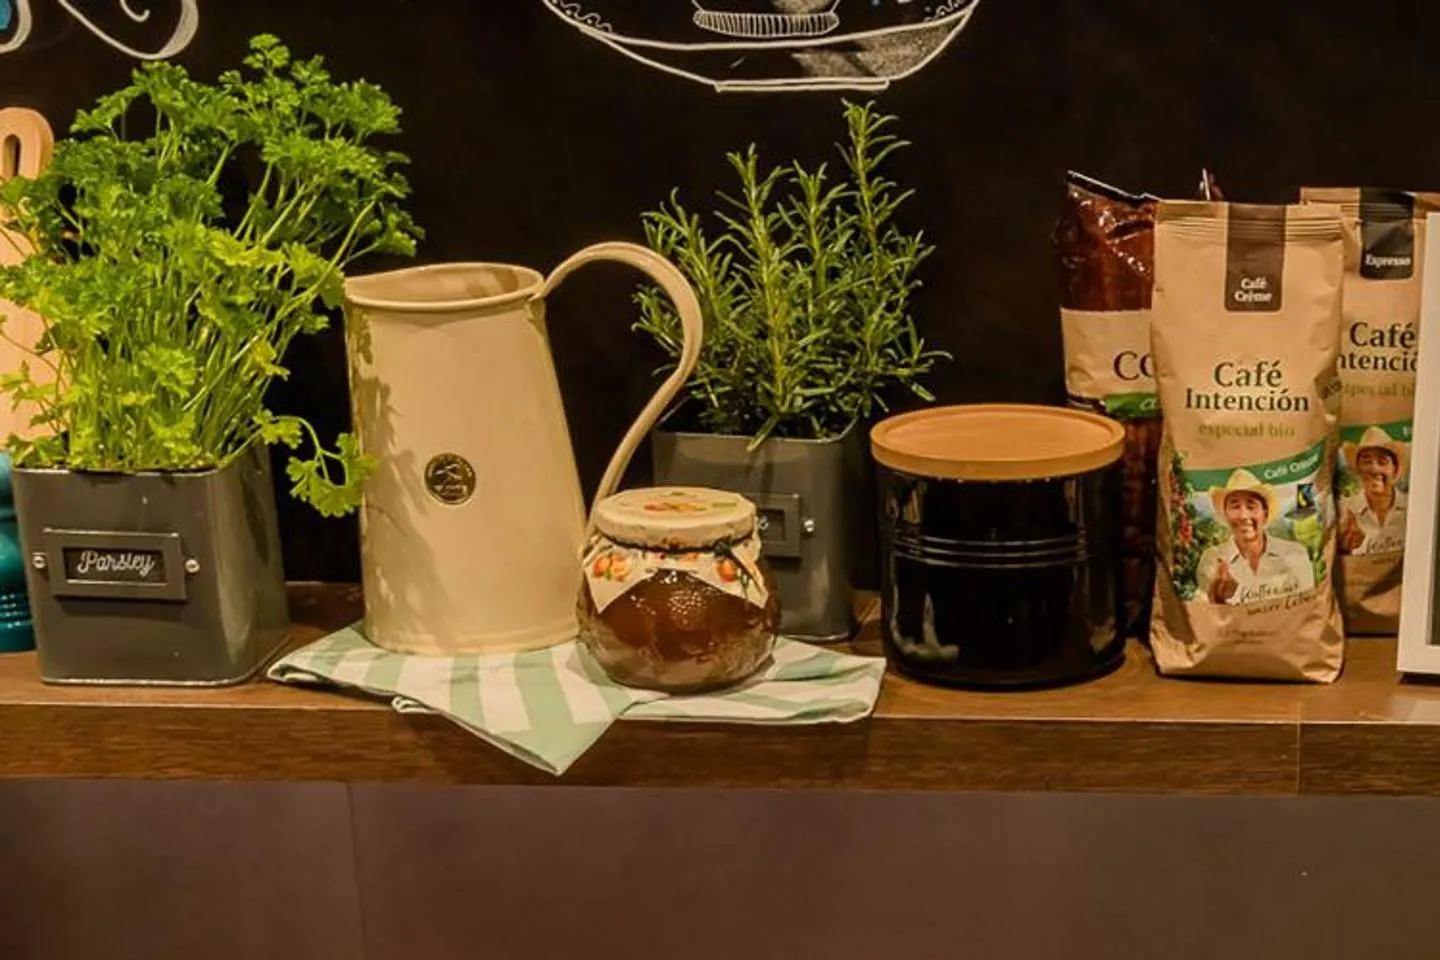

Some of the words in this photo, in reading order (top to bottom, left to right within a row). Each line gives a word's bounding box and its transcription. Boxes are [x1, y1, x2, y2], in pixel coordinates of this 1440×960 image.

[1350, 322, 1415, 349] Café
[1336, 350, 1418, 372] ntenció
[1213, 360, 1282, 388] Café
[1185, 388, 1310, 412] Intención
[1198, 423, 1264, 439] especial
[1269, 422, 1296, 438] bio
[77, 550, 155, 578] Parsley
